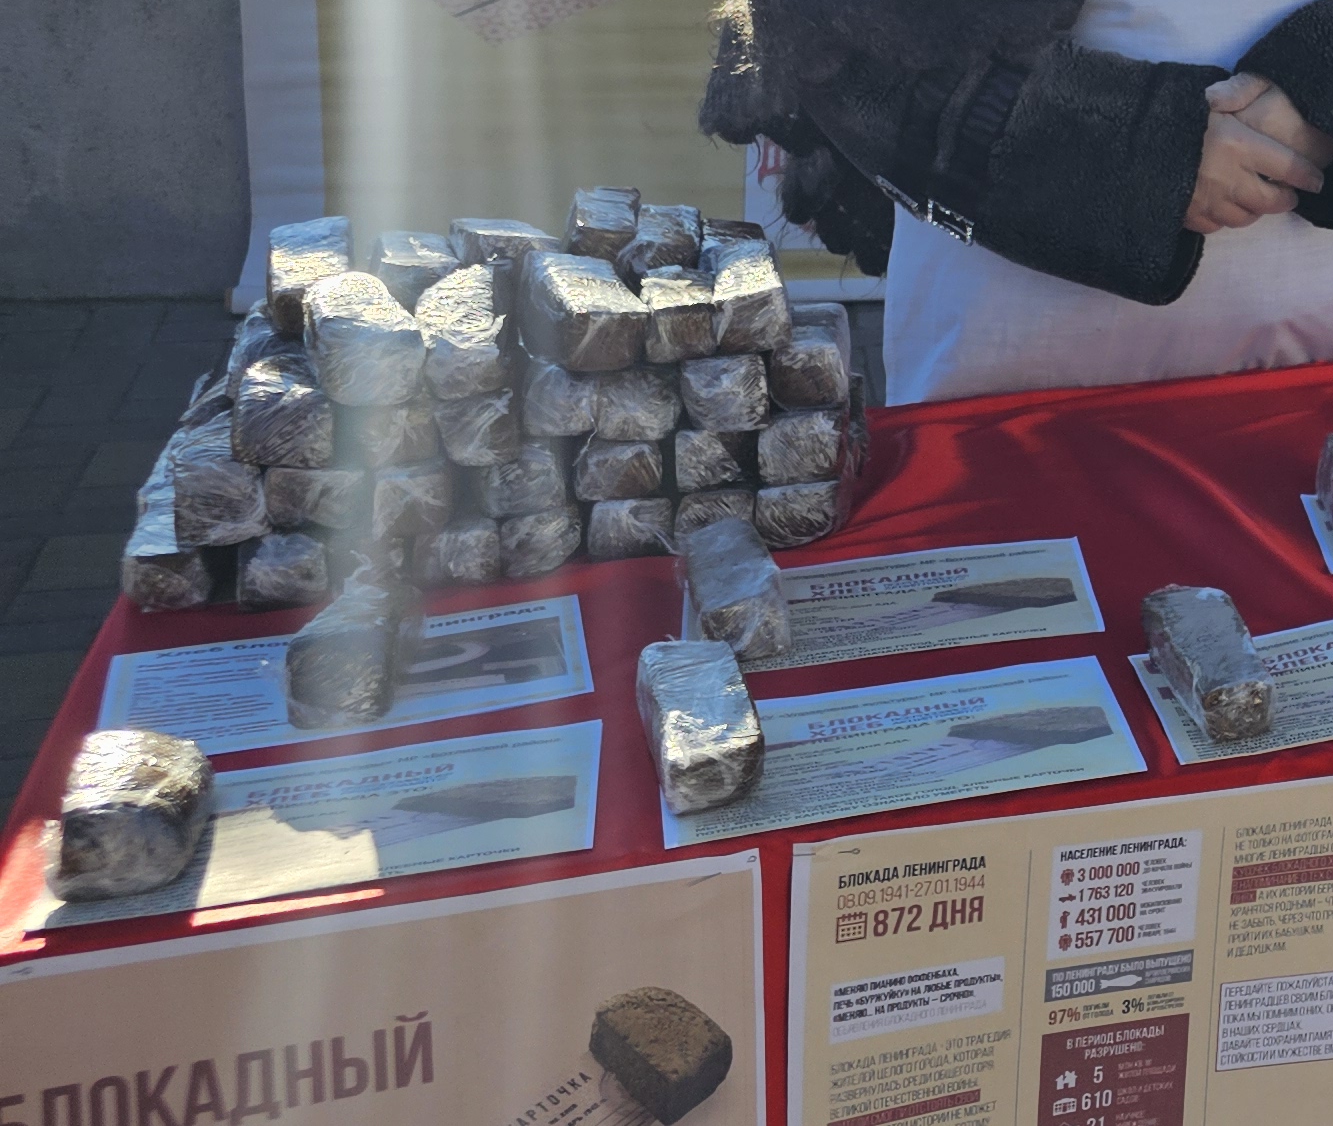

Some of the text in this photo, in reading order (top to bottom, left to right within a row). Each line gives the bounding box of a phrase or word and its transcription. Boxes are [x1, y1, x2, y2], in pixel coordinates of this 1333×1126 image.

[807, 696, 985, 730] БЛОКАДНЫЙ
[1061, 837, 1187, 862] НАСЕЛЕНИЕ ЛЕНИНГРАДА:
[838, 856, 986, 889] БЛОКАДА ЛЕНИНГРАДА
[873, 896, 984, 937] 872 ДНЯ
[1075, 908, 1101, 926] 431
[1107, 903, 1136, 921] 000
[1075, 925, 1134, 949] 557 700
[1048, 1008, 1080, 1025] 97%
[1122, 998, 1144, 1014] 3%
